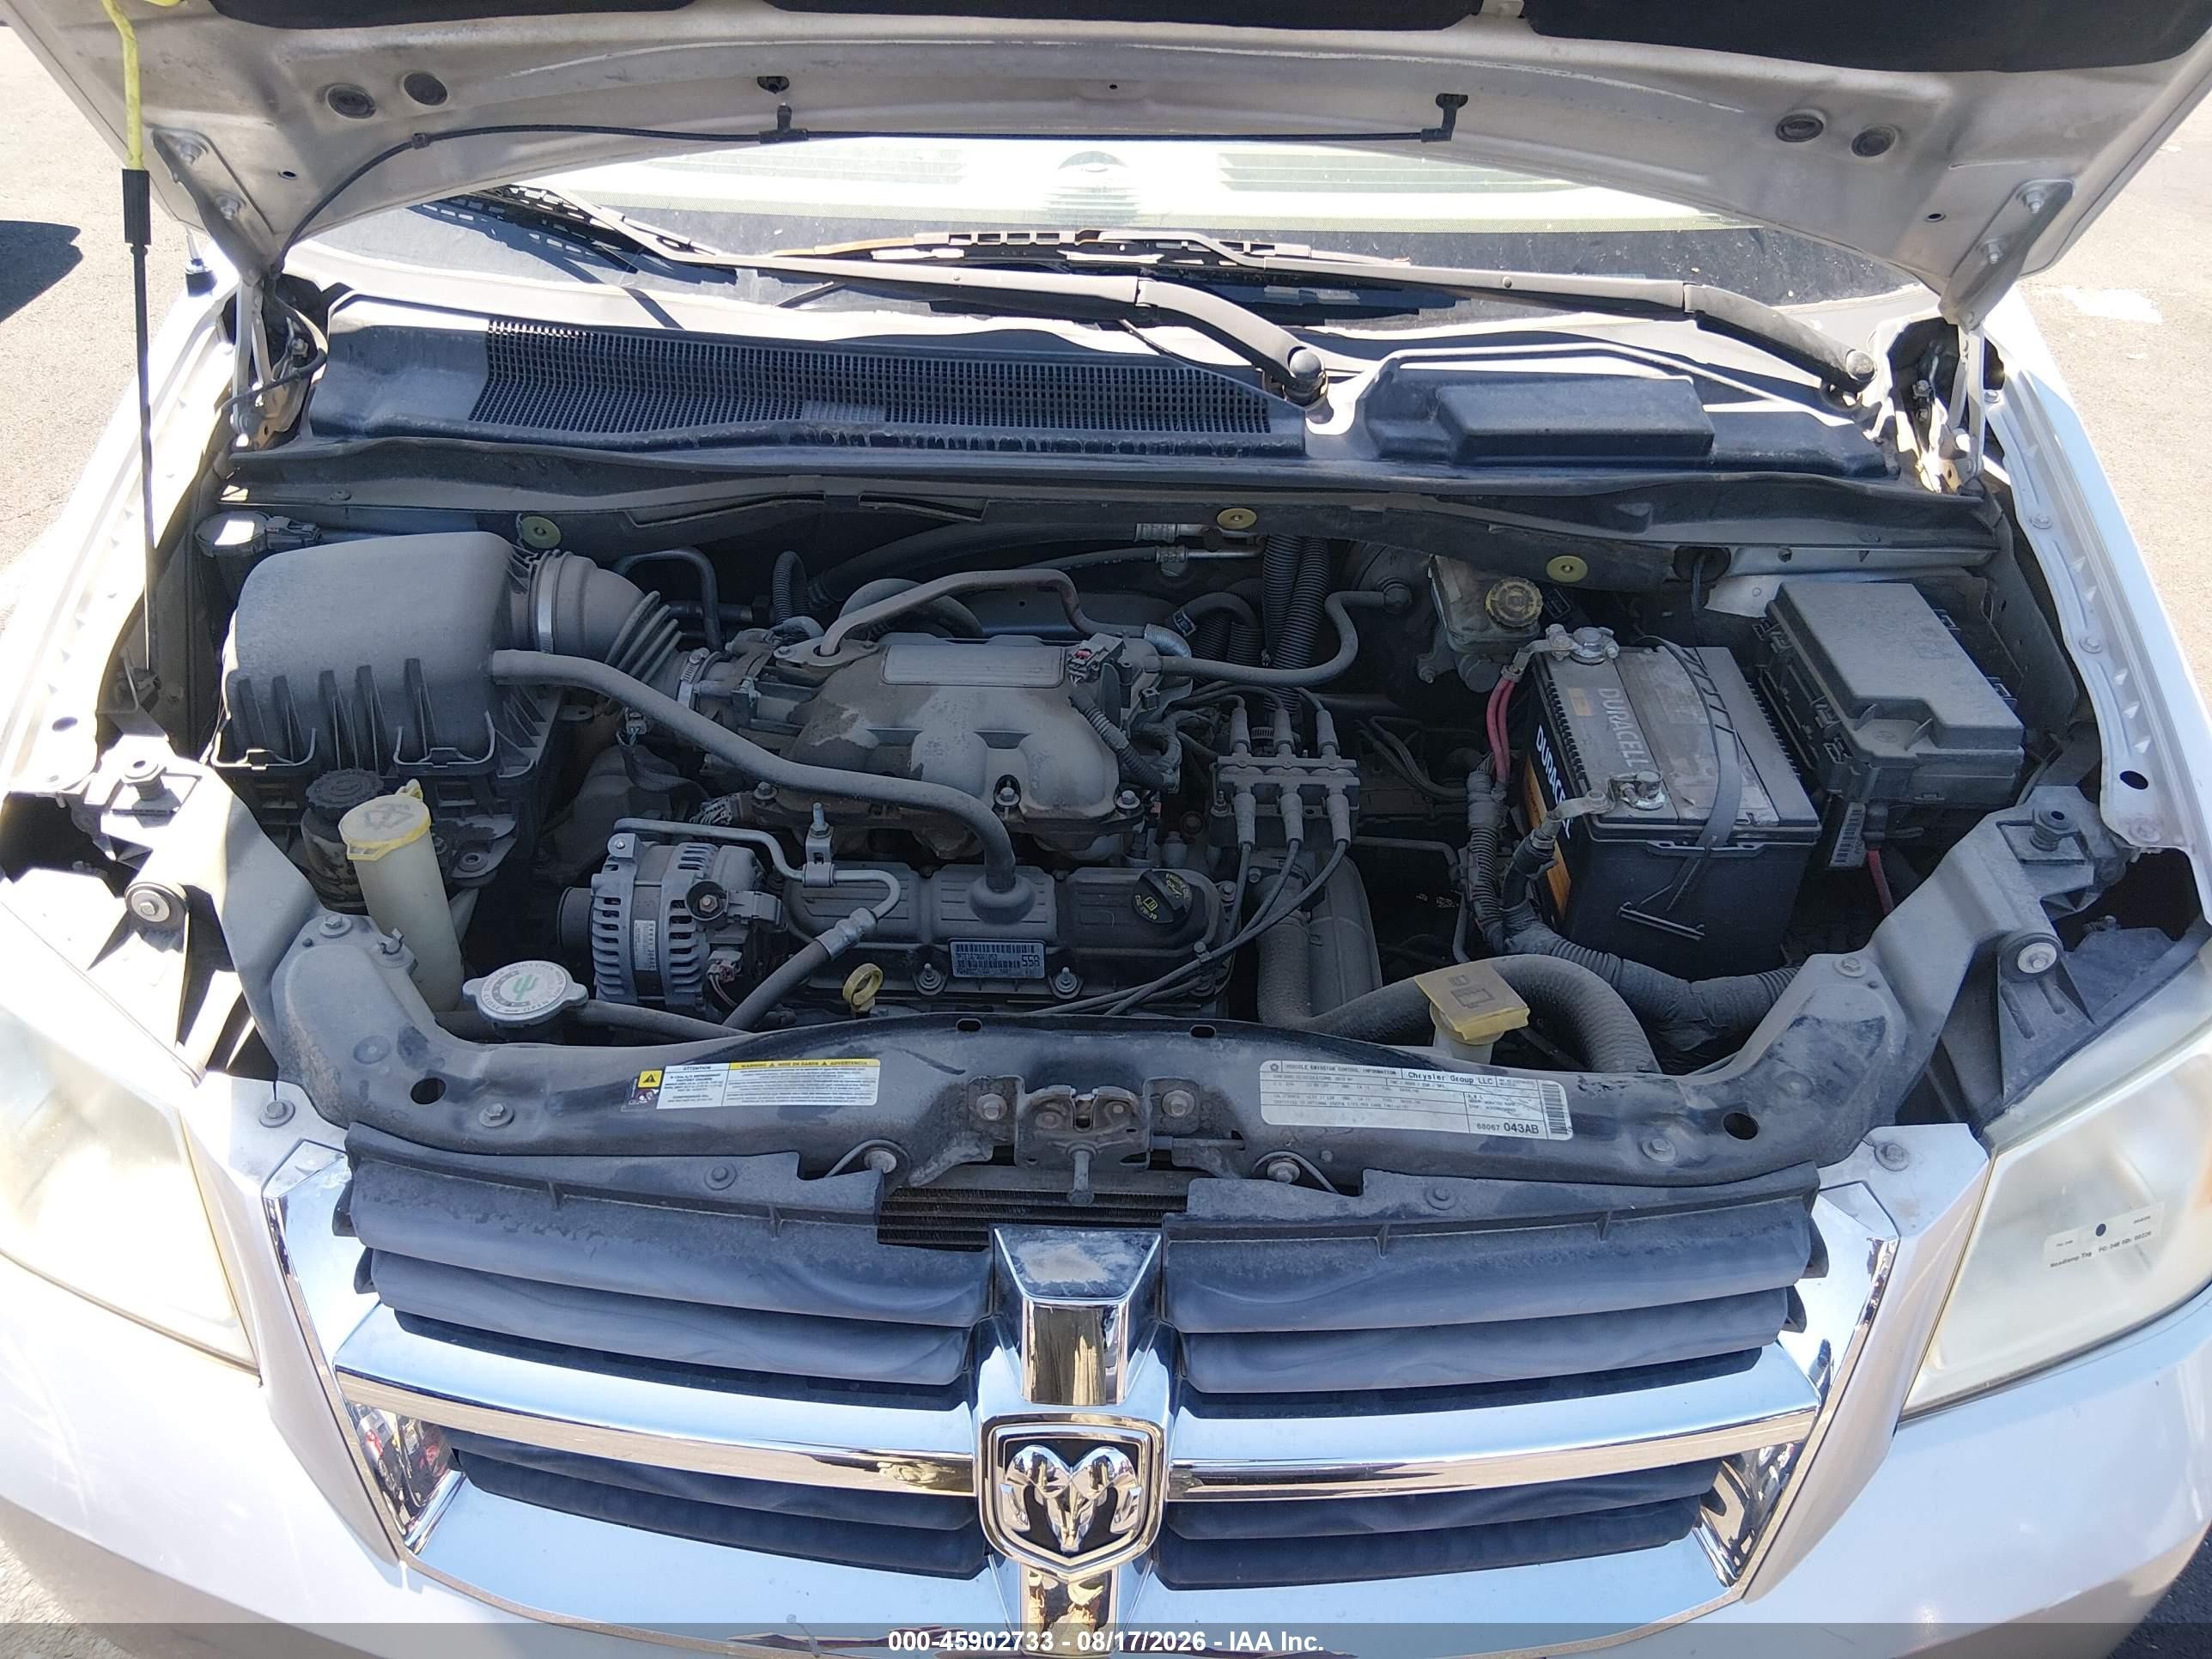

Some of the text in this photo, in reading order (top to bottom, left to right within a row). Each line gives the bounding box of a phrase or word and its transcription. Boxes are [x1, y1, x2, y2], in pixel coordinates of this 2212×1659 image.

[1597, 688, 1650, 767] DURACELL
[1407, 1072, 1445, 1082] Chrysler
[1449, 1074, 1474, 1085] Group
[1504, 1121, 1540, 1134] 043AB
